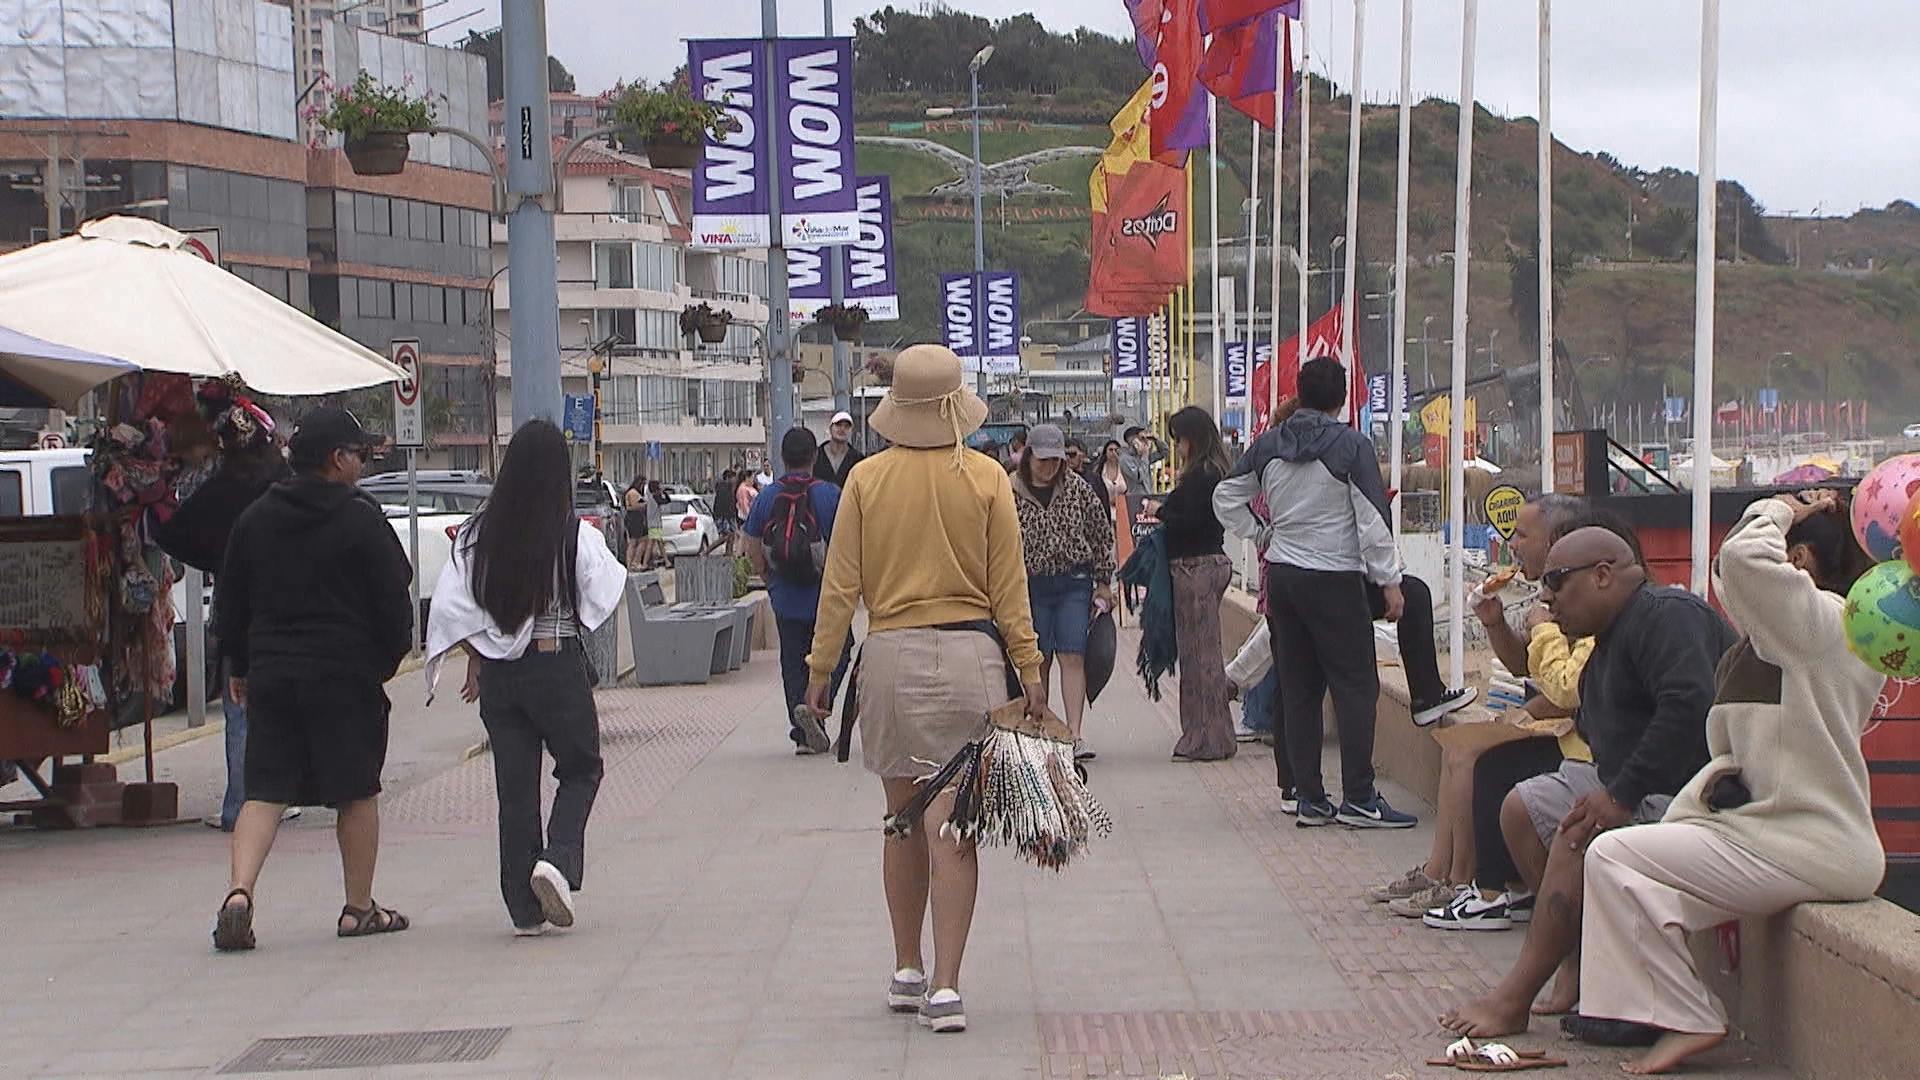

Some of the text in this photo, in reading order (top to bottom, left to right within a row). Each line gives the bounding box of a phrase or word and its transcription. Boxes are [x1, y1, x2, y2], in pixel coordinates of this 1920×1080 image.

[702, 49, 755, 202] WOM
[788, 49, 843, 200] WOM
[850, 182, 887, 289] WOM
[946, 277, 973, 350] WOM
[988, 277, 1014, 350] WOM
[1116, 316, 1137, 373] WOM
[1227, 344, 1246, 393] WOM
[1371, 375, 1386, 411] WOM
